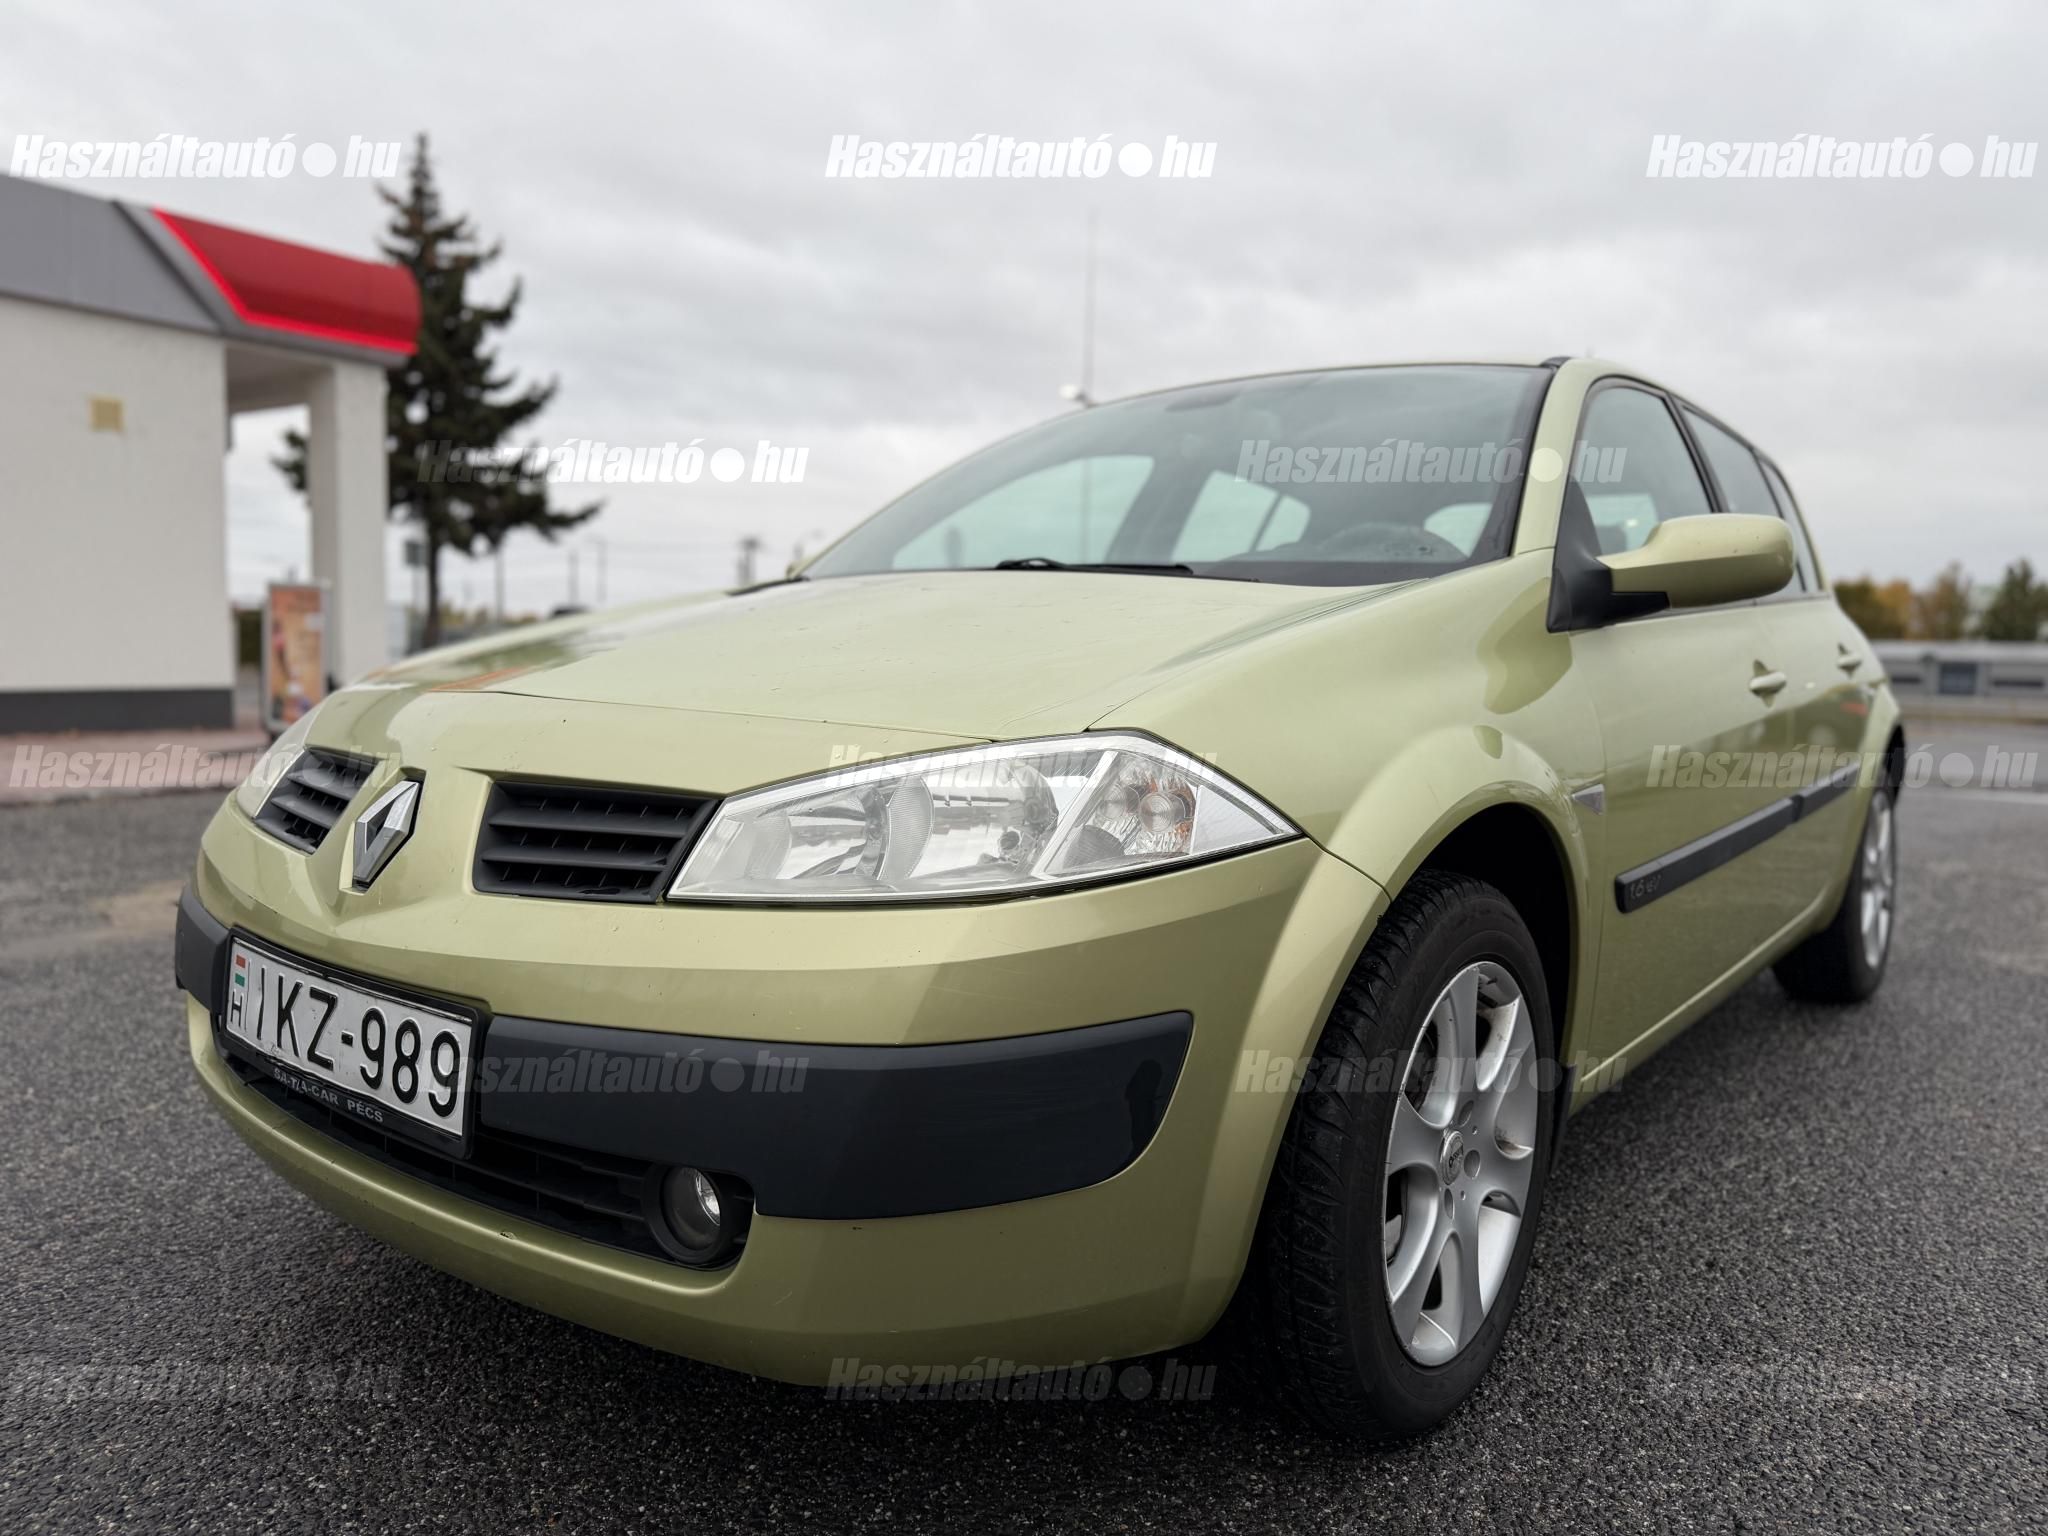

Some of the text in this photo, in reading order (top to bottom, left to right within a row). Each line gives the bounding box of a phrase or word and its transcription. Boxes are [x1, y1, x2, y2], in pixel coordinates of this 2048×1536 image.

[230, 991, 244, 1028] H
[256, 965, 461, 1118] IKZ-989
[346, 1099, 384, 1123] PÉCS
